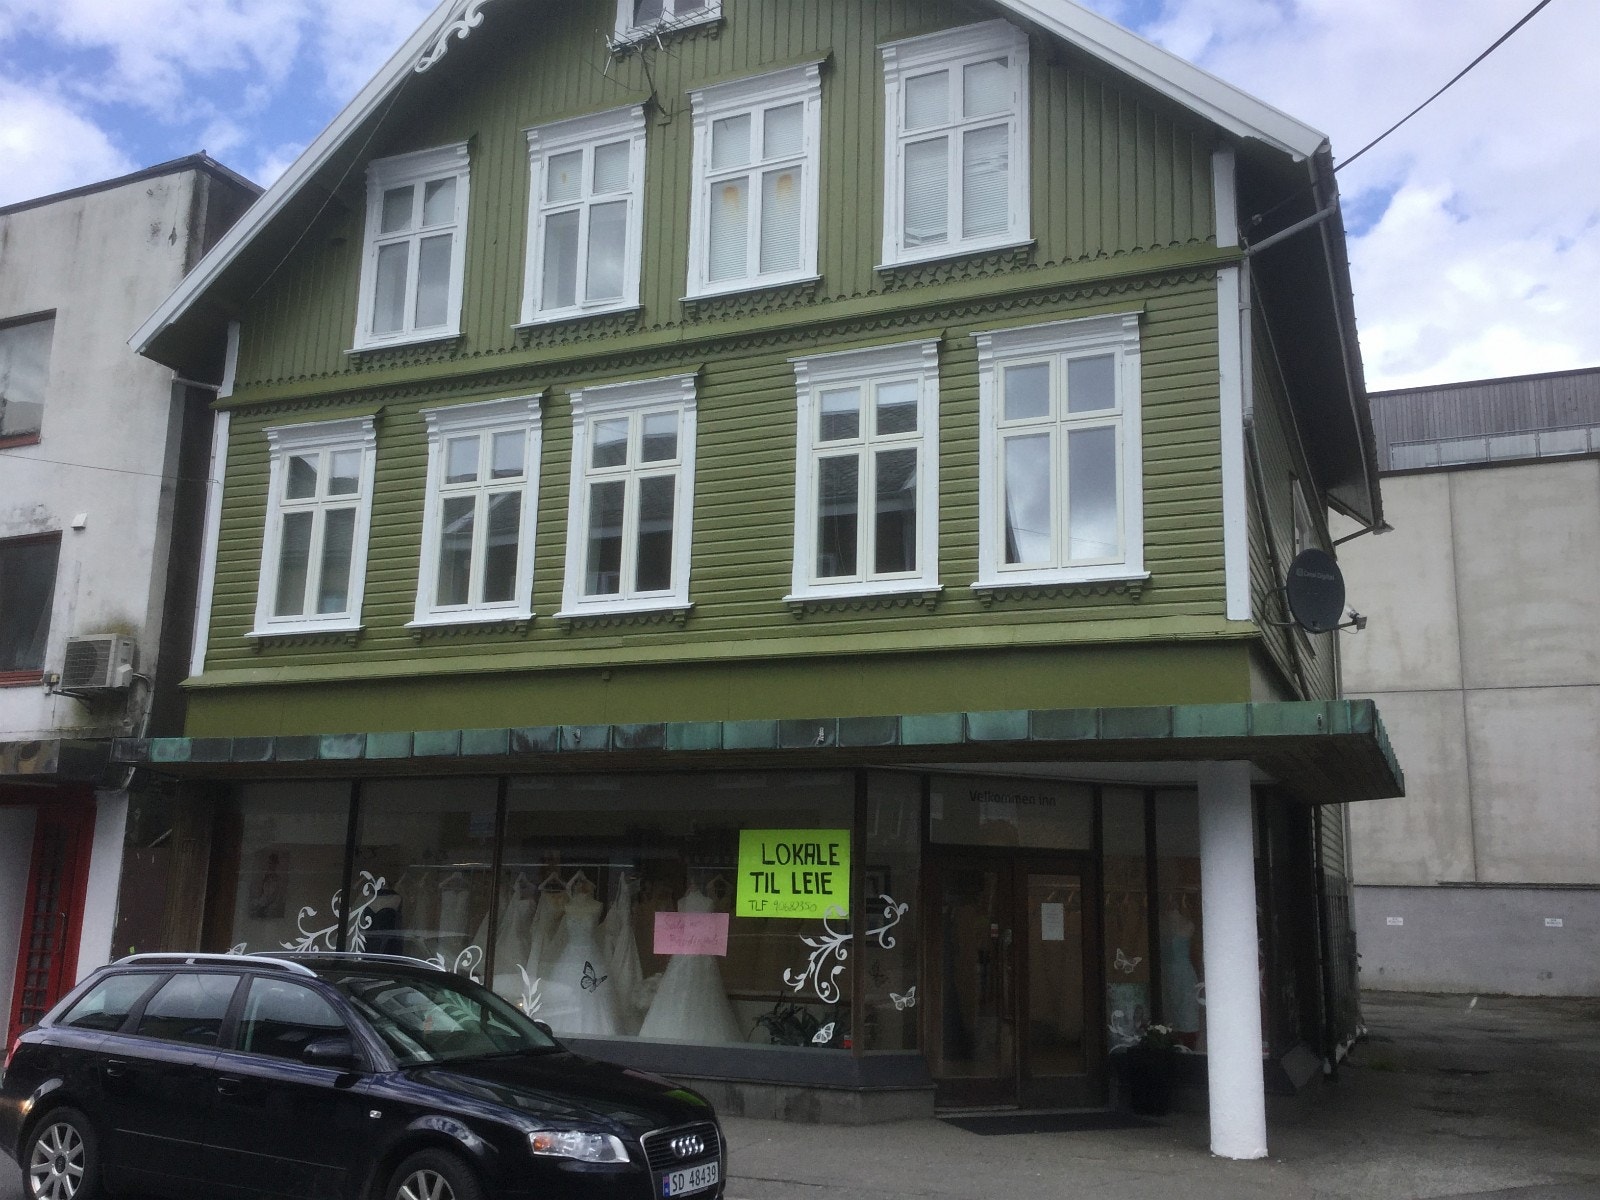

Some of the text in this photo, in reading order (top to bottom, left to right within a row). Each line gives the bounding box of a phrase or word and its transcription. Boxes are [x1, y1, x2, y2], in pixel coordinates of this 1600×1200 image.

[969, 789, 1056, 806] Velkommen inn
[761, 843, 840, 866] LOKALE
[749, 871, 834, 895] TIL LEIE
[748, 900, 768, 911] TLF
[672, 1165, 717, 1192] SD 48439
